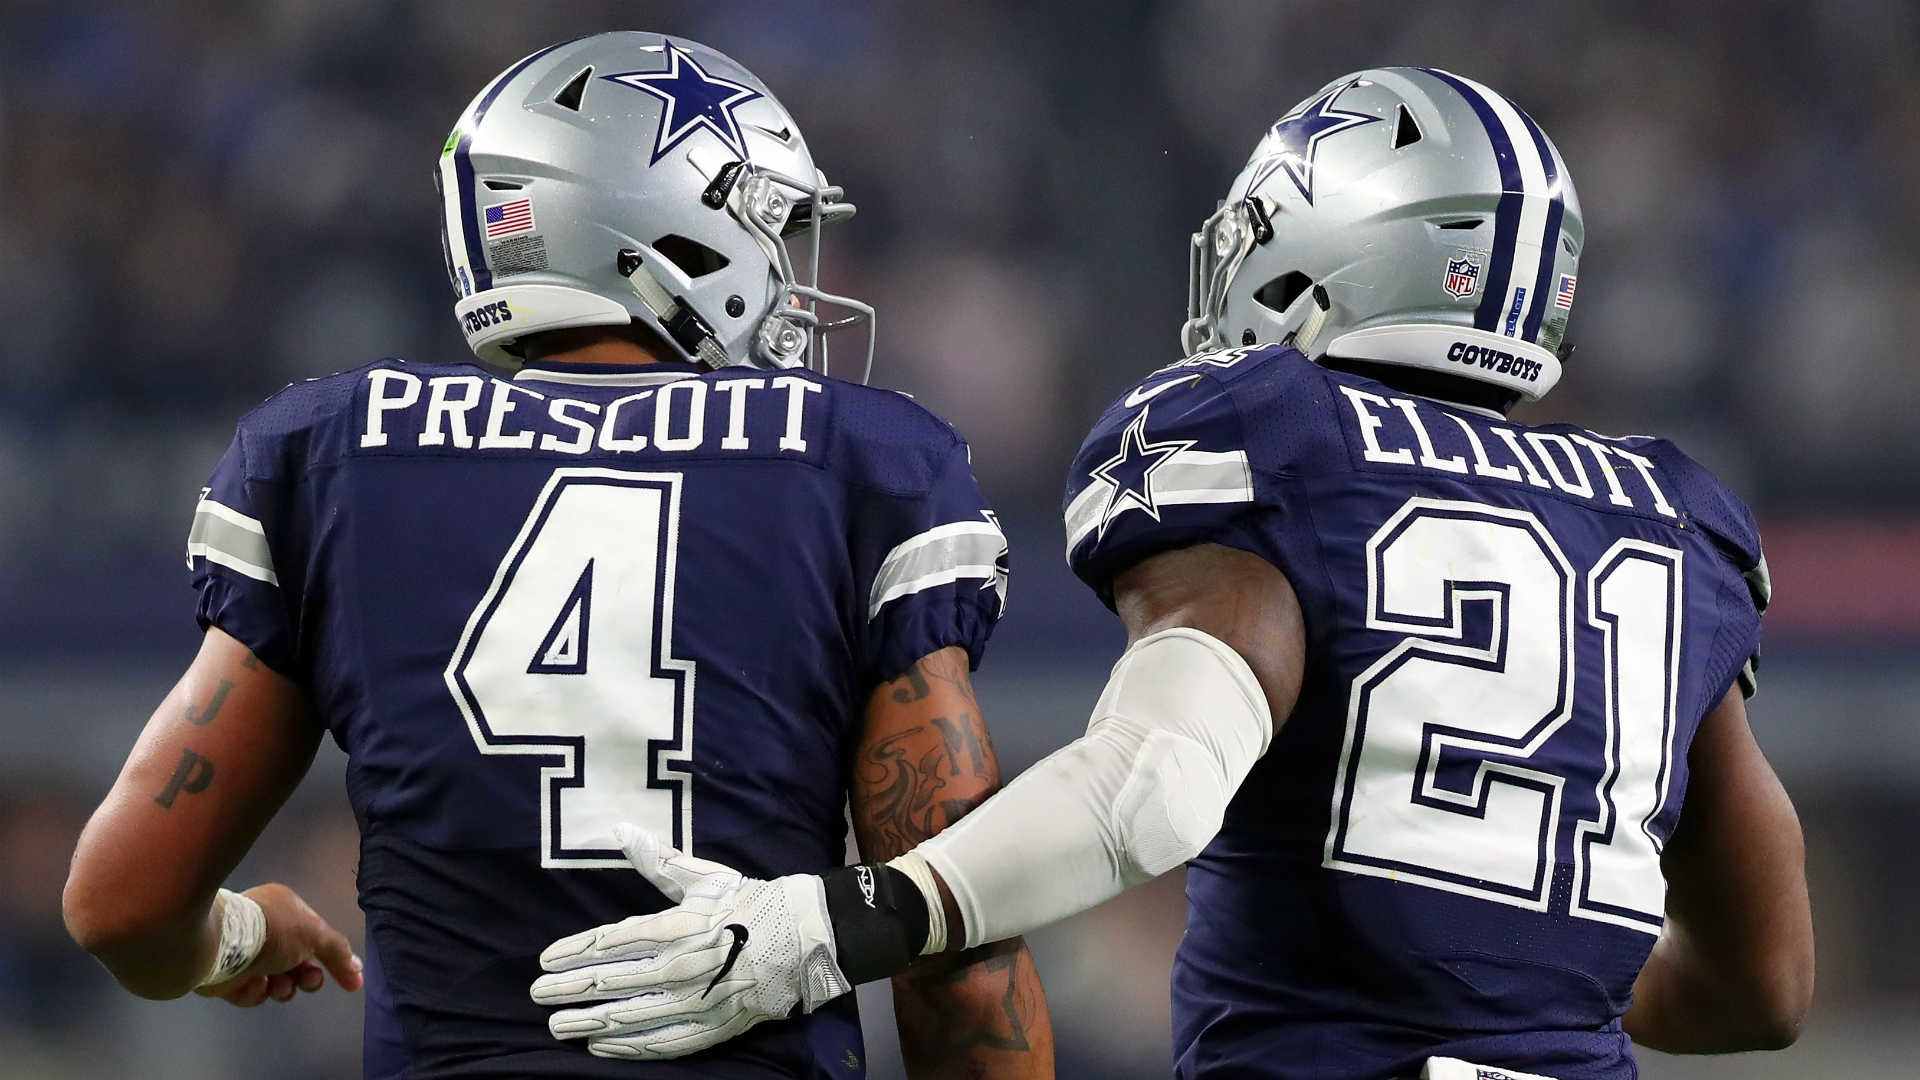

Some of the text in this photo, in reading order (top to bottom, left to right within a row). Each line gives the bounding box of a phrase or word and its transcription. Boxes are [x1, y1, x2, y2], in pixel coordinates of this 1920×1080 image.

[463, 300, 512, 336] WBOYS
[1448, 273, 1473, 294] NFL
[1447, 342, 1543, 382] COWBOYS
[360, 368, 823, 454] PRESCOTT
[1339, 384, 1678, 518] ELLIOTT
[443, 467, 697, 869] 4
[1321, 496, 1684, 936] 21
